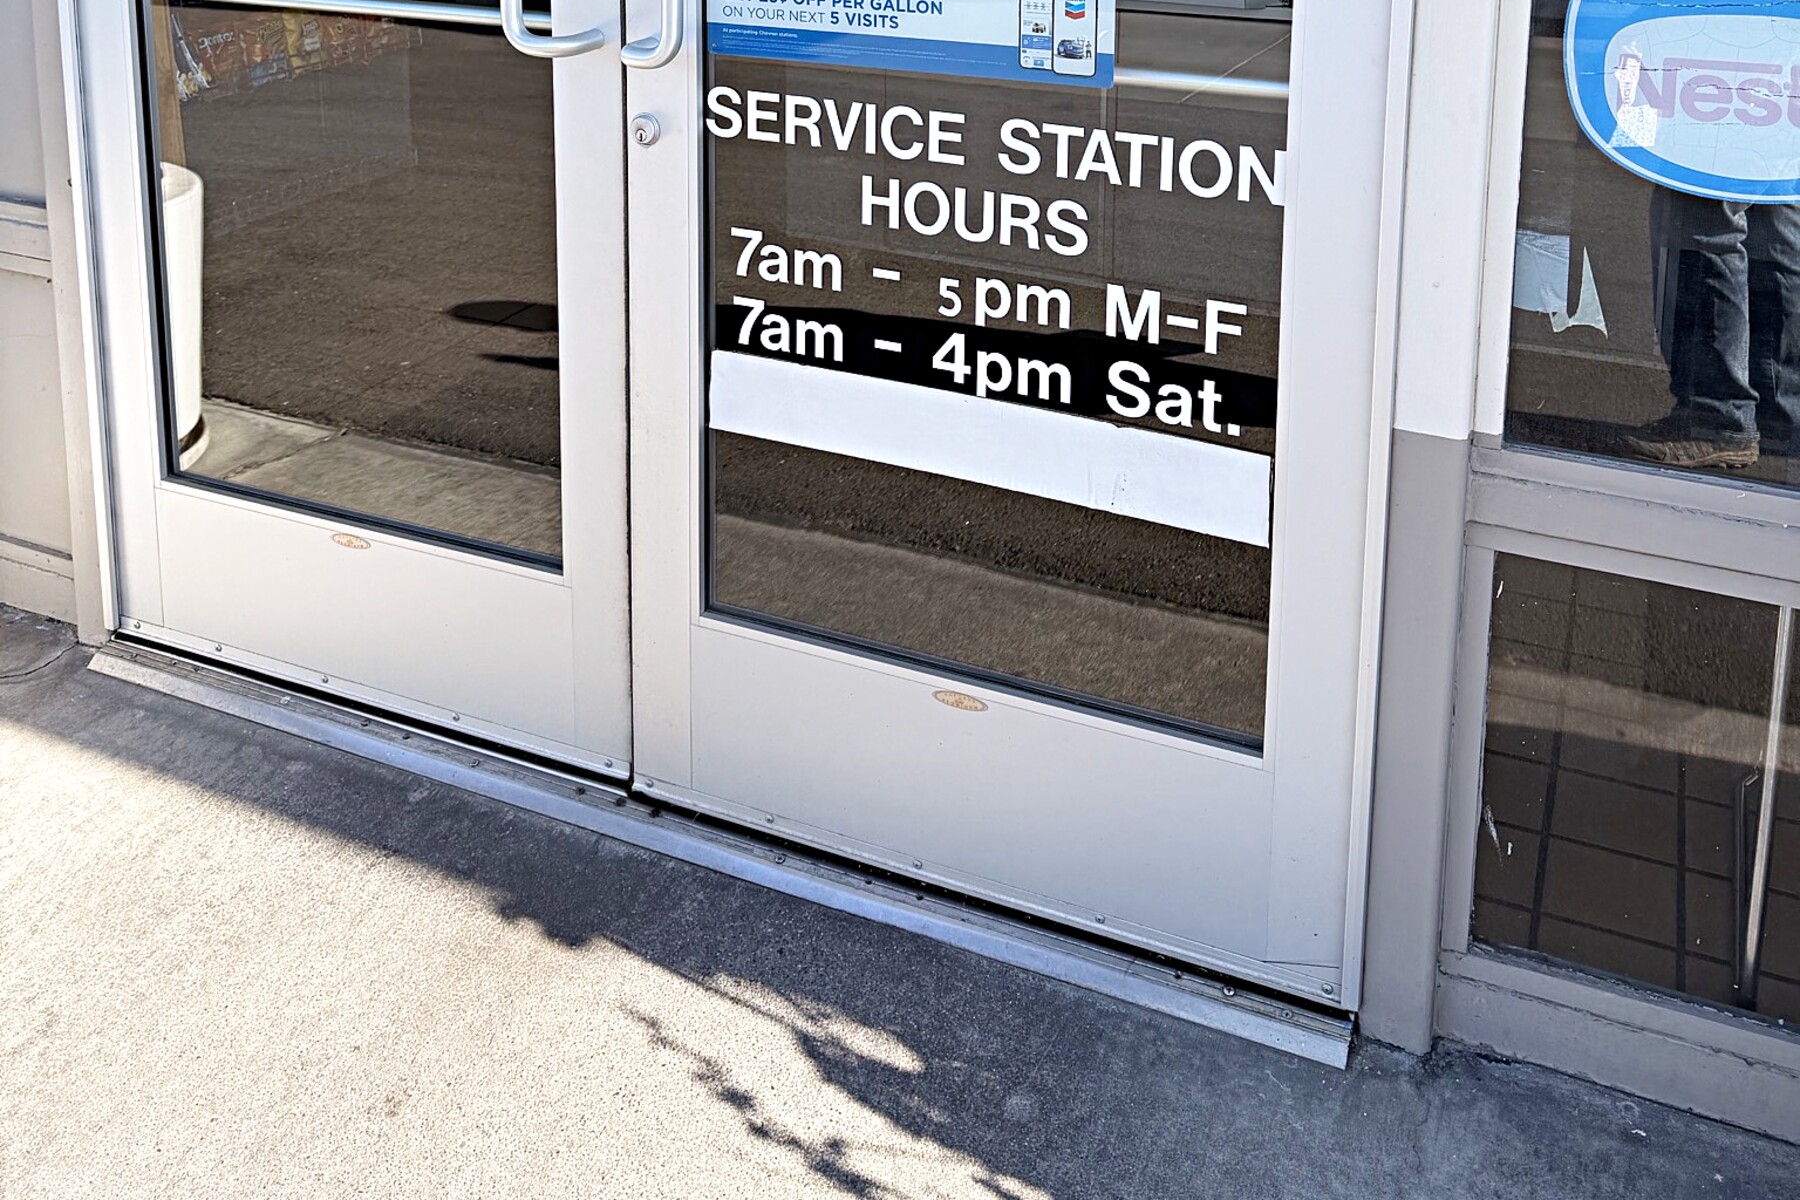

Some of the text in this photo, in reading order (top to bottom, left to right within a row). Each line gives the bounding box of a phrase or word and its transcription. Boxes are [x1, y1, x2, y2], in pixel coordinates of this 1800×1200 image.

[722, 5, 899, 29] ON YOUR NEXT 5 VISITS
[705, 85, 1288, 208] SERVICE STATION
[860, 175, 1090, 257] HOURS
[730, 227, 843, 292] 7am
[1105, 282, 1248, 356] M-F
[733, 296, 844, 362] 7am
[932, 332, 1072, 404] 4pm
[1106, 360, 1241, 438] Sat.
